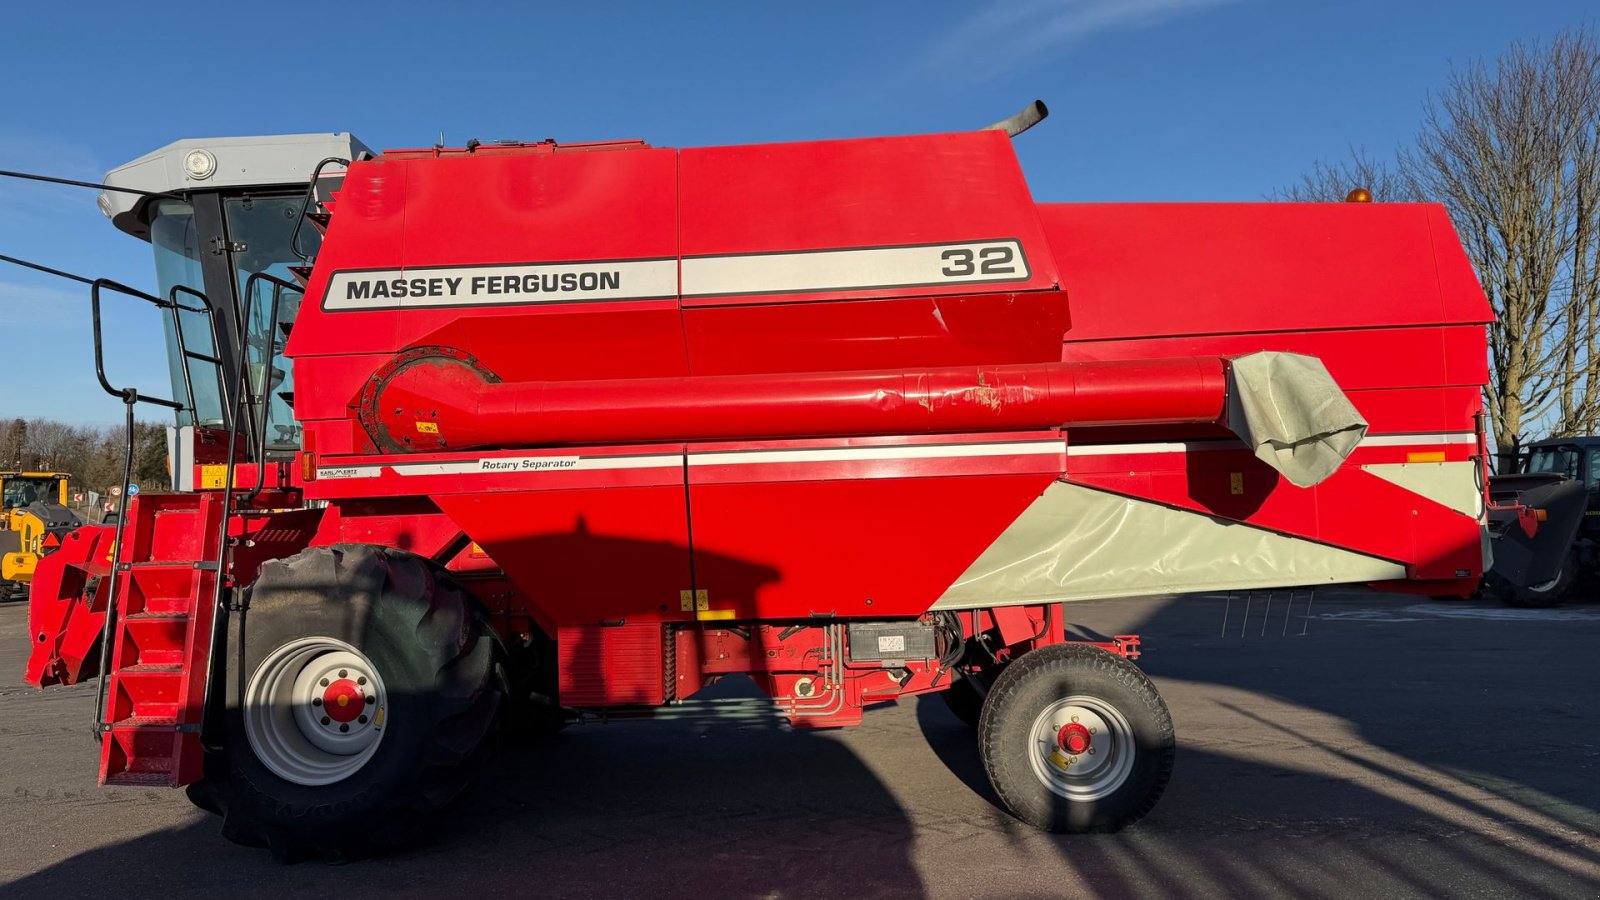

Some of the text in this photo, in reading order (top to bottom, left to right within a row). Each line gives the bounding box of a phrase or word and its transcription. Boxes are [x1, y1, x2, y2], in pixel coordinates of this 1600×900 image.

[941, 246, 1015, 277] 32
[346, 271, 620, 299] MASSEY FERGUSON
[482, 459, 576, 470] Rotary Separator
